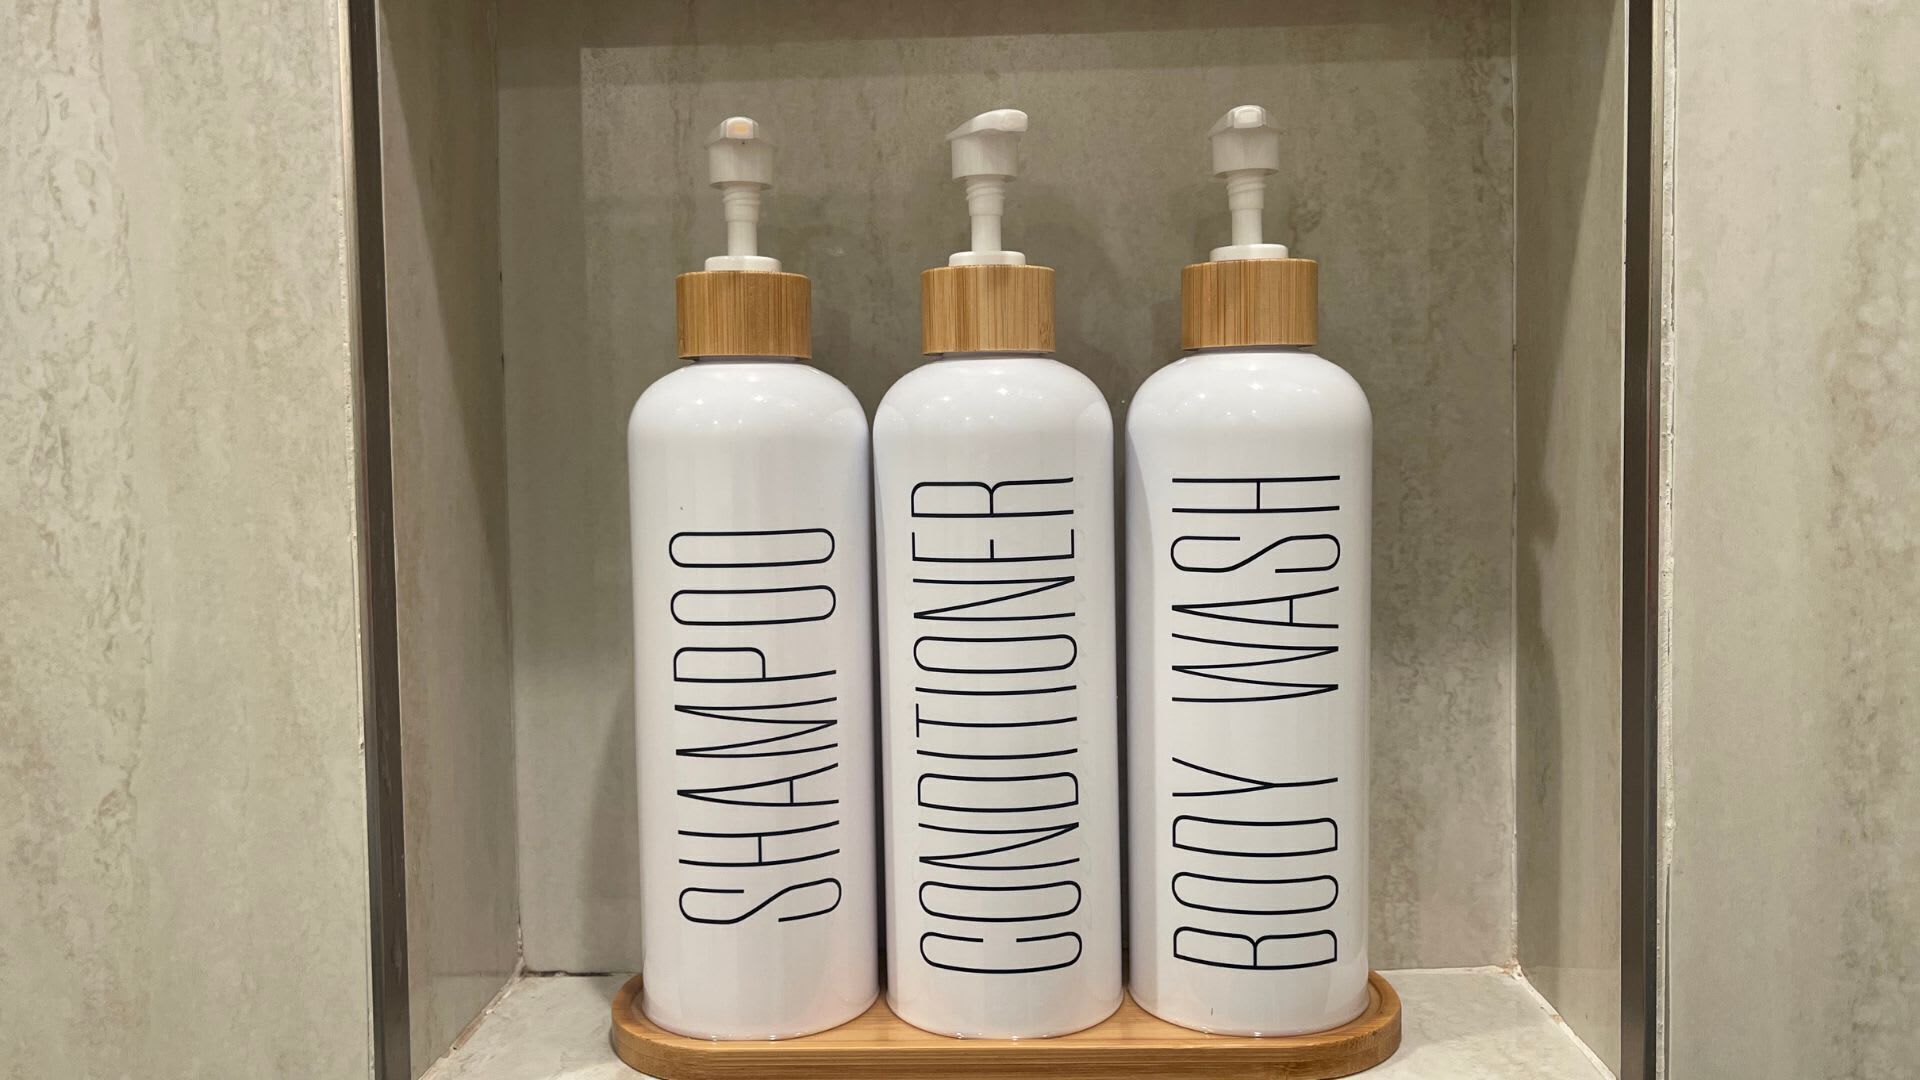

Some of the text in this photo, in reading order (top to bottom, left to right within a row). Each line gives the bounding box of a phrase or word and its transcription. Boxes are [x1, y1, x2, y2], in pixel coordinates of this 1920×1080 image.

[669, 528, 842, 925] SHAMPOO
[911, 477, 1082, 974] CONDITIONER
[1170, 475, 1340, 970] BODY WASH
